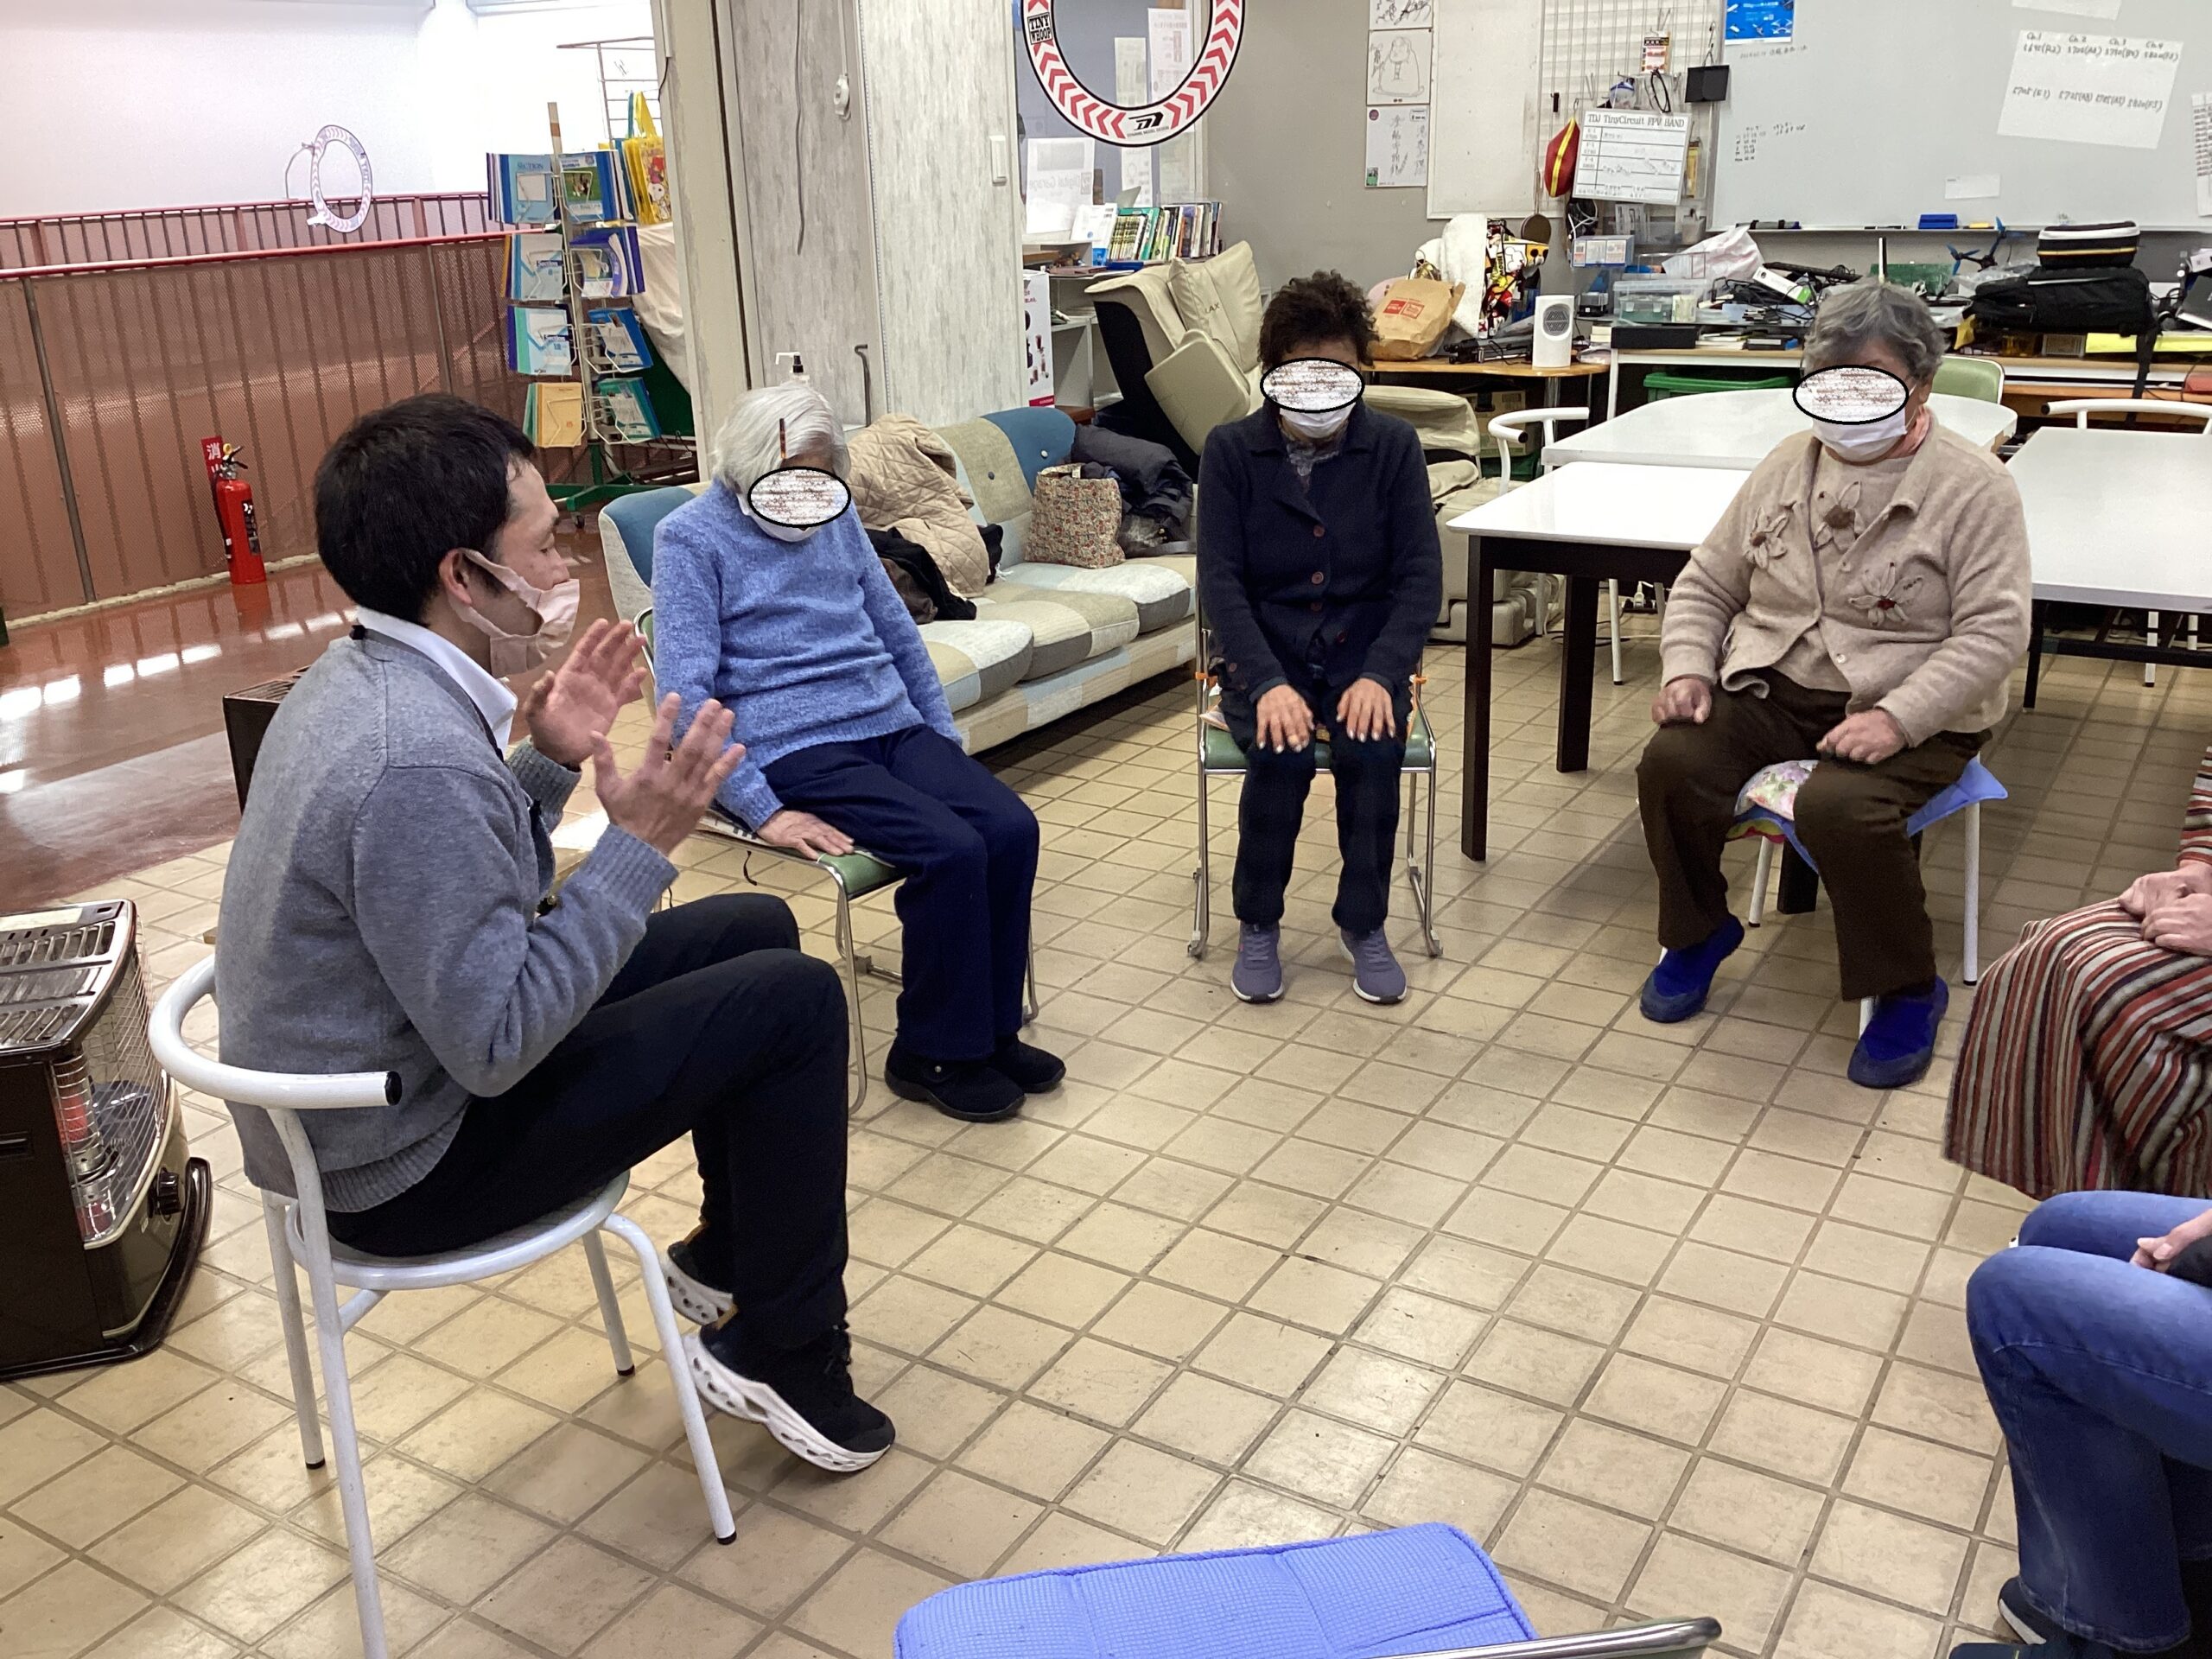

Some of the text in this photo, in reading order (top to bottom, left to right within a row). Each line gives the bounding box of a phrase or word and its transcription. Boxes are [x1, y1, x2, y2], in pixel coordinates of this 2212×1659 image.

[1029, 15, 1049, 29] TINY
[1030, 28, 1051, 41] WHOOP
[1604, 114, 1644, 125] TinyCircuit
